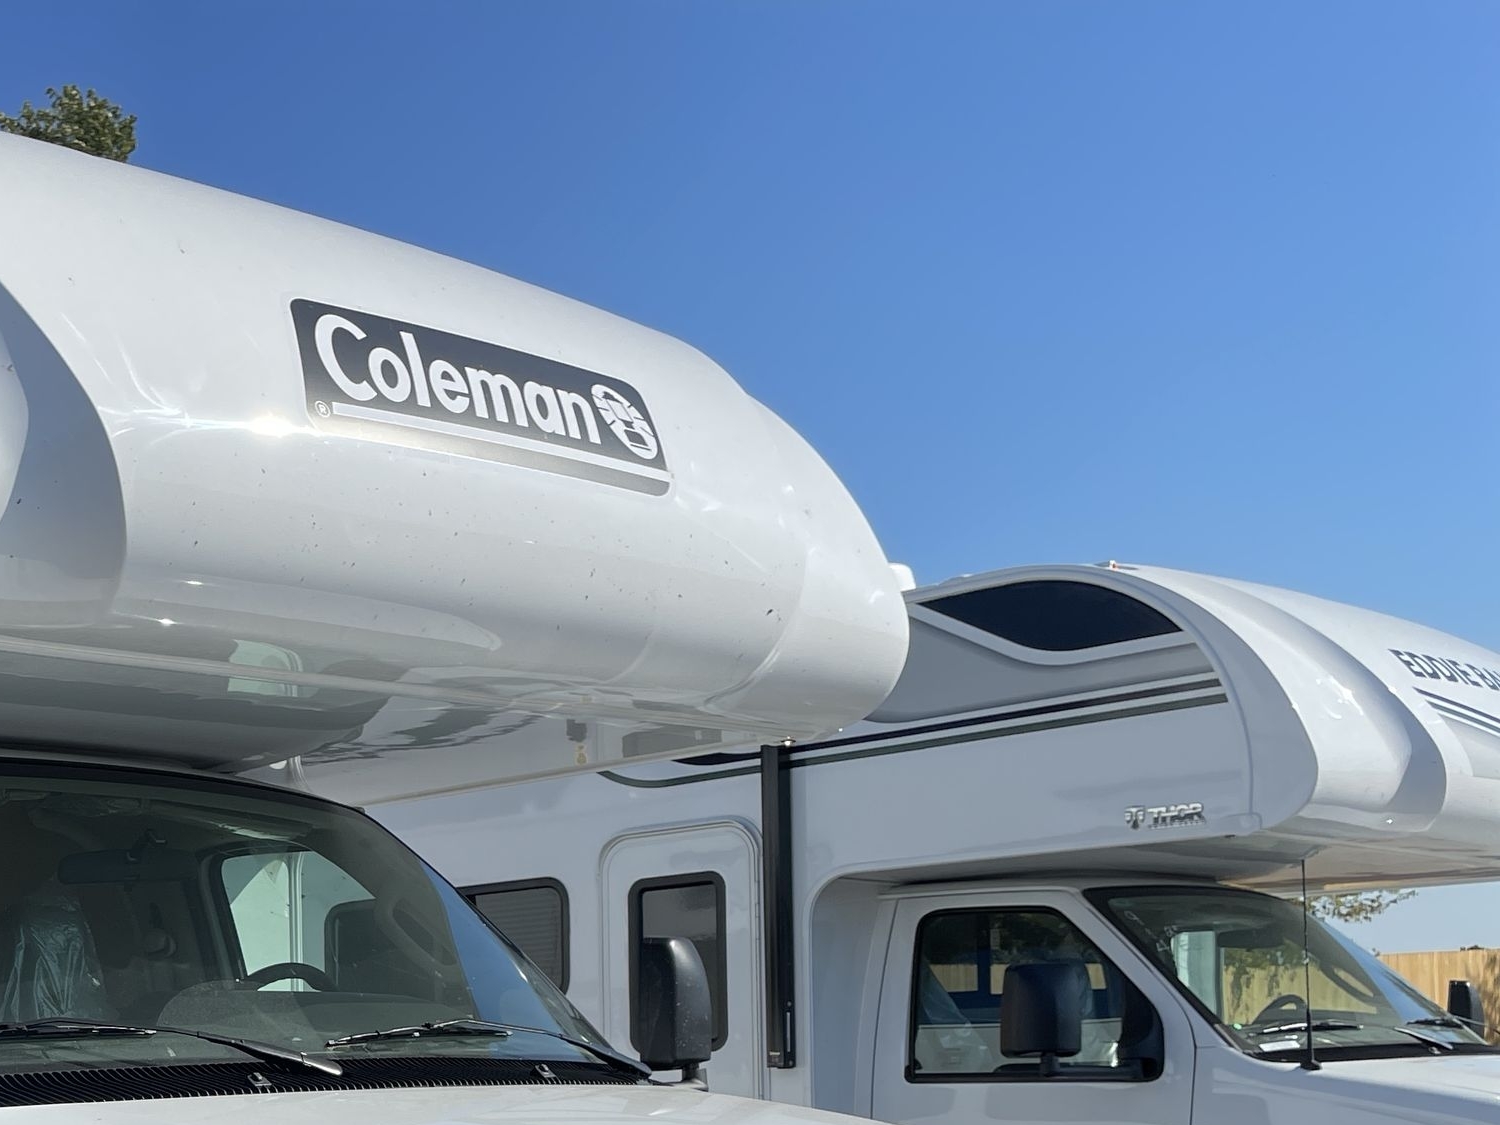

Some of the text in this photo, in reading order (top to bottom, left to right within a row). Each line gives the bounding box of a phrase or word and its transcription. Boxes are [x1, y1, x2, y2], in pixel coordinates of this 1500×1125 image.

[314, 313, 602, 444] Coleman
[1387, 648, 1483, 688] EDDIE
[1147, 803, 1206, 827] THOR
